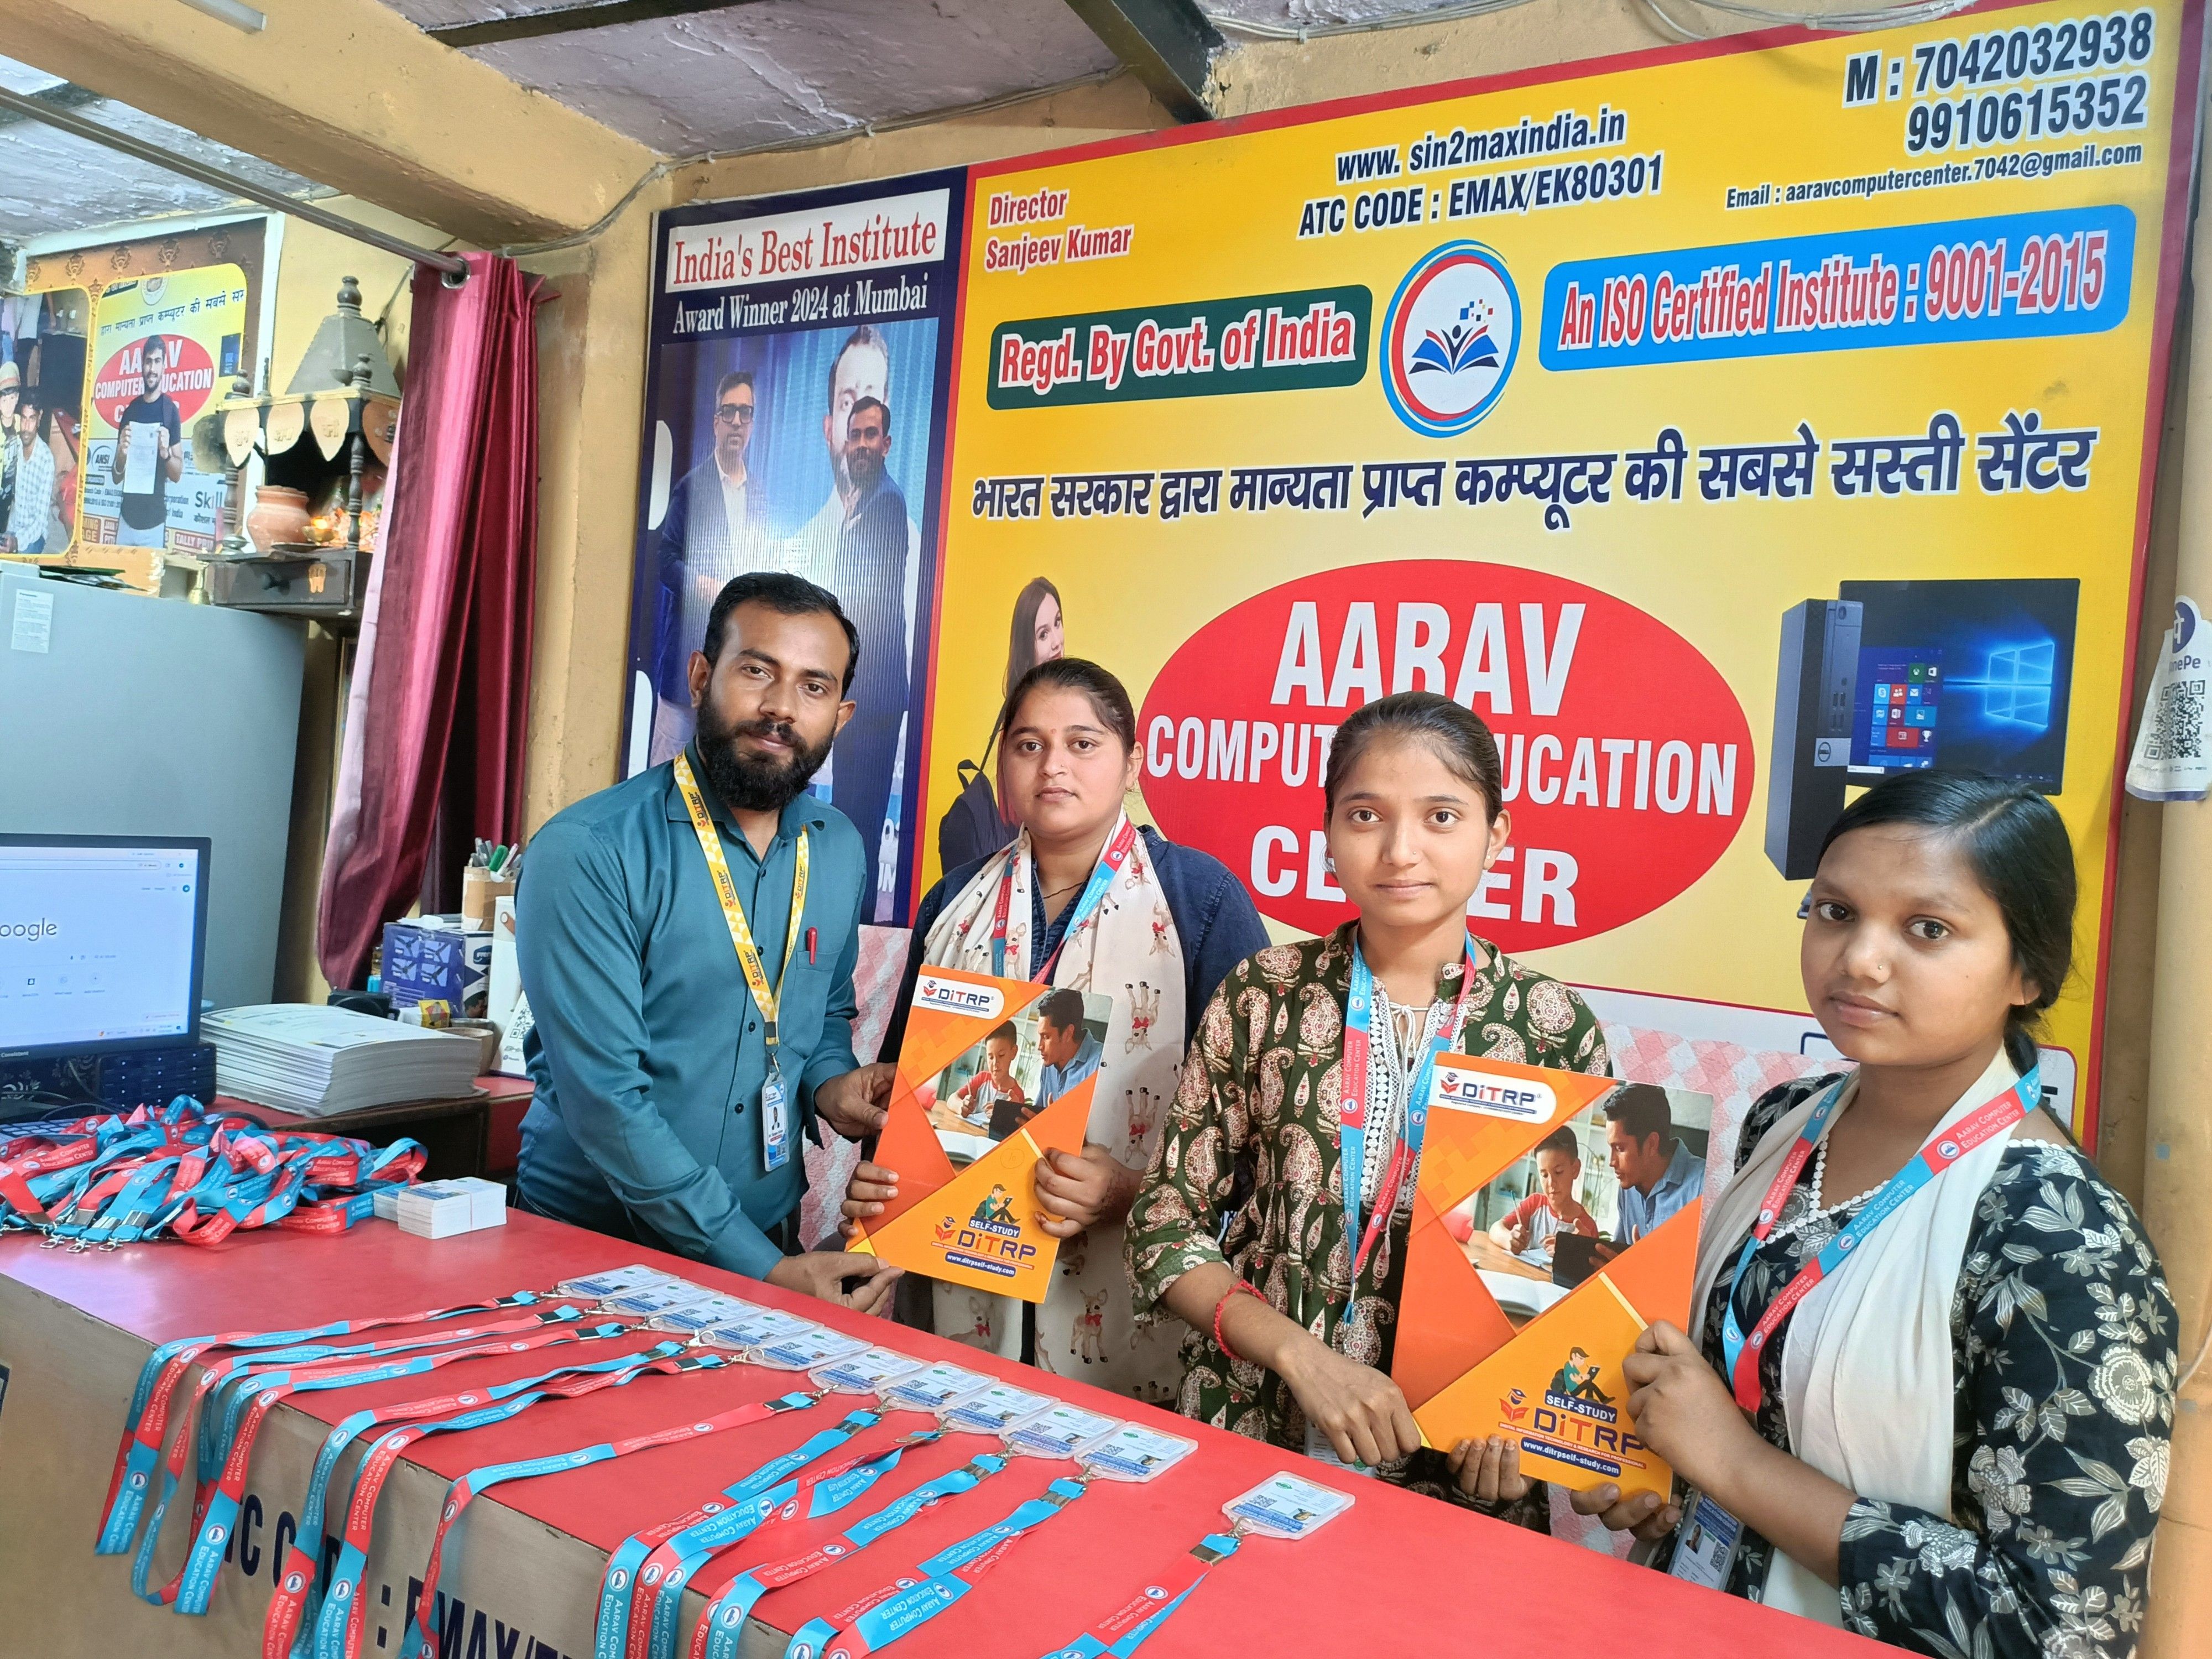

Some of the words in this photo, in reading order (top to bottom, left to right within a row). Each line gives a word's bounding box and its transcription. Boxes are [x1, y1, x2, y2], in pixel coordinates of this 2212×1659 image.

[1846, 54, 1879, 103] M
[1889, 60, 1903, 97] :
[1913, 12, 2152, 92] 7042032938
[1907, 75, 2146, 152] 9910615352
[1337, 150, 1401, 182] www.
[1409, 107, 1626, 171] sin2maxindia.in
[1726, 184, 1771, 210] Email
[1785, 142, 2143, 202] aaravcomputercenter.7042@gmail.com
[990, 190, 1068, 226] Director
[1298, 198, 1345, 237] ATC
[1354, 187, 1423, 231] CODE
[1449, 154, 1663, 217] EMAX/EK80301
[673, 233, 753, 285] India's
[759, 229, 814, 275] Best
[820, 211, 937, 268] Institute
[985, 236, 1061, 273] Sanjeev
[1066, 226, 1133, 260] Kumar
[672, 296, 724, 334] Award
[729, 293, 789, 329] Winner
[790, 285, 829, 323] 2024
[832, 289, 851, 318] at
[853, 272, 928, 315] Mumbai
[1559, 285, 1595, 346] An
[1600, 278, 1647, 343] ISO
[1653, 265, 1768, 339] Certified
[1776, 255, 1897, 328] Institute
[1926, 233, 2106, 319] 9001-2015
[1001, 333, 1080, 390] Regd.
[1091, 328, 1128, 385] By
[1135, 321, 1212, 373] Govt.
[1223, 314, 1257, 366] of
[1266, 307, 1352, 362] India
[161, 368, 212, 393] UCATION
[972, 477, 1044, 518] भारत
[1051, 472, 1155, 516] सरकार
[1160, 469, 1223, 520] द्वारा
[1229, 465, 1354, 511] मान्यता
[1362, 460, 1447, 520] प्राप्त
[1454, 453, 1618, 531] कम्प्यूटर
[1625, 427, 1688, 500] की
[1698, 422, 1819, 500] सबसे
[1830, 413, 1965, 495] सस्ती
[1976, 411, 2099, 492] सेंटर
[1270, 601, 1586, 717] AARAV
[1146, 714, 1340, 789] COMPUT
[1491, 733, 1738, 816] UCATION
[1250, 824, 1579, 928] CEER
[1345, 1040, 1354, 1072] COMPUTER
[1354, 1039, 1362, 1064] CENTER
[1352, 1065, 1360, 1098] EDUCATION
[1955, 1122, 1980, 1141] AARAV
[1978, 1100, 2013, 1125] COMPUTER
[1960, 1123, 2000, 1150] EDUCATION
[1998, 1109, 2021, 1126] CENTER
[1766, 1183, 1781, 1205] AARAV
[1777, 1151, 1797, 1183] COMPUTER
[1771, 1177, 1793, 1209] EDUCATION
[1790, 1150, 1806, 1173] CENTER
[1853, 1211, 1875, 1231] AARAV
[1873, 1179, 1906, 1210] COMPUTER
[1856, 1206, 1891, 1238] EDUCATION
[1889, 1183, 1914, 1206] CENTER
[969, 1219, 1019, 1238] SELF-STUDY
[947, 1254, 1015, 1276] www.ditrpself-study.com
[1762, 1305, 1779, 1326] AARAV
[1778, 1275, 1808, 1305] COMPUTER
[1763, 1300, 1792, 1334] EDUCATION
[1791, 1278, 1815, 1301] CENTER
[154, 1362, 179, 1402] EDUCATION
[165, 1368, 181, 1393] AARAV
[144, 1404, 158, 1433] CENTER
[155, 1394, 168, 1432] COMPUTER
[248, 1411, 260, 1439] AARAV
[1546, 1394, 1616, 1422] SELF-STUDY
[237, 1406, 258, 1451] EDUCATION
[226, 1451, 239, 1481] CENTER
[234, 1441, 249, 1482] COMPUTER
[359, 1449, 387, 1497] EDUCATION
[373, 1454, 391, 1484] AARAV
[1523, 1440, 1620, 1474] www.ditrpself-study.com
[352, 1499, 364, 1531] CENTER
[360, 1485, 377, 1531] COMPUTER
[716, 1504, 755, 1526] EDUCATION
[736, 1516, 757, 1530] AARAV
[689, 1522, 718, 1538] CENTER
[699, 1526, 736, 1544] COMPUTER
[763, 1563, 790, 1577] CENTER
[774, 1566, 809, 1583] COMPUTER
[787, 1550, 824, 1568] EDUCATION
[807, 1556, 830, 1571] AARAV
[880, 1600, 910, 1620] CENTER
[906, 1585, 935, 1605] EDUCATION
[922, 1596, 941, 1613] AARAV
[1115, 1595, 1147, 1617] EDUCATION
[1135, 1600, 1155, 1614] AARAV
[889, 1609, 924, 1631] COMPUTER
[1095, 1615, 1120, 1630] CENTER
[1109, 1612, 1139, 1632] COMPUTER
